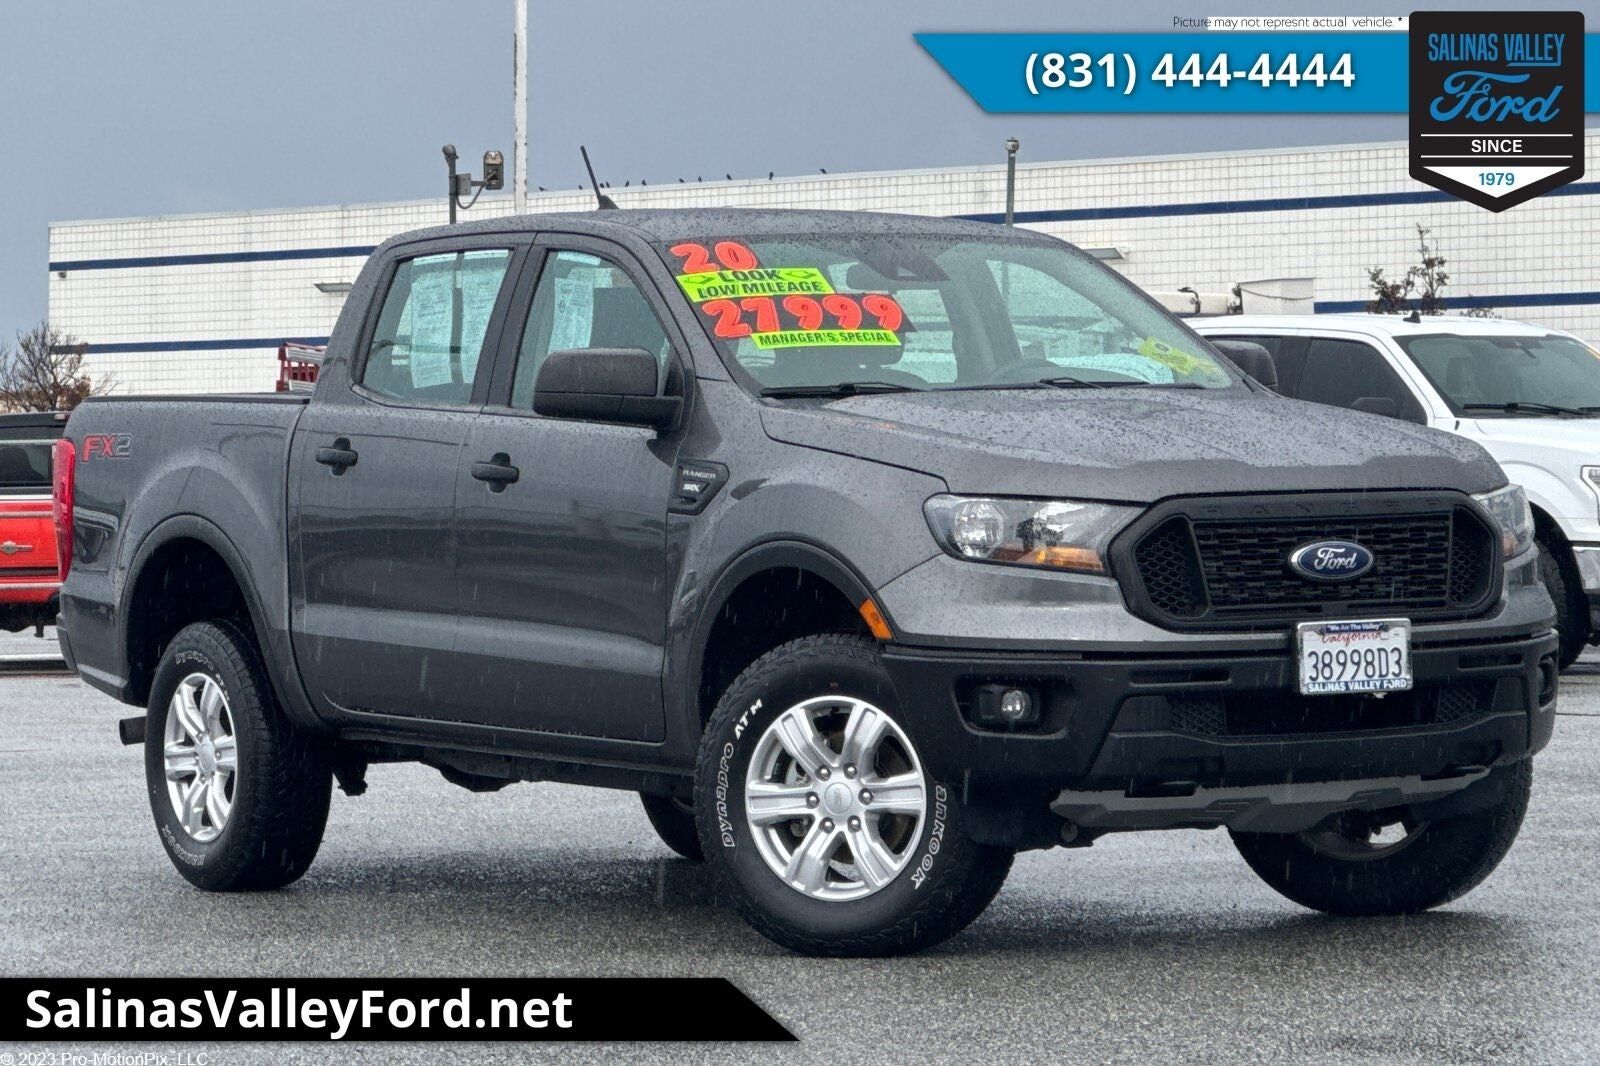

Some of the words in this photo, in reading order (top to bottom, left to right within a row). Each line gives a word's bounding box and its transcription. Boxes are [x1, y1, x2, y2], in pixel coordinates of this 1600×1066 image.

[670, 241, 758, 274] 20
[718, 269, 784, 283] LOOK
[696, 284, 737, 299] LOW
[741, 281, 824, 295] MILEAGE
[701, 294, 903, 338] 27999
[758, 332, 836, 346] MANAGER'S
[838, 331, 893, 343] SPECIAL
[81, 432, 134, 464] FX2
[682, 469, 717, 480] RANGER
[1313, 547, 1358, 571] Ford
[1321, 631, 1382, 648] California
[1308, 647, 1403, 682] 38998D3
[1308, 682, 1347, 692] SALINAS
[1347, 680, 1381, 691] VALLEY
[1383, 679, 1408, 689] FORD
